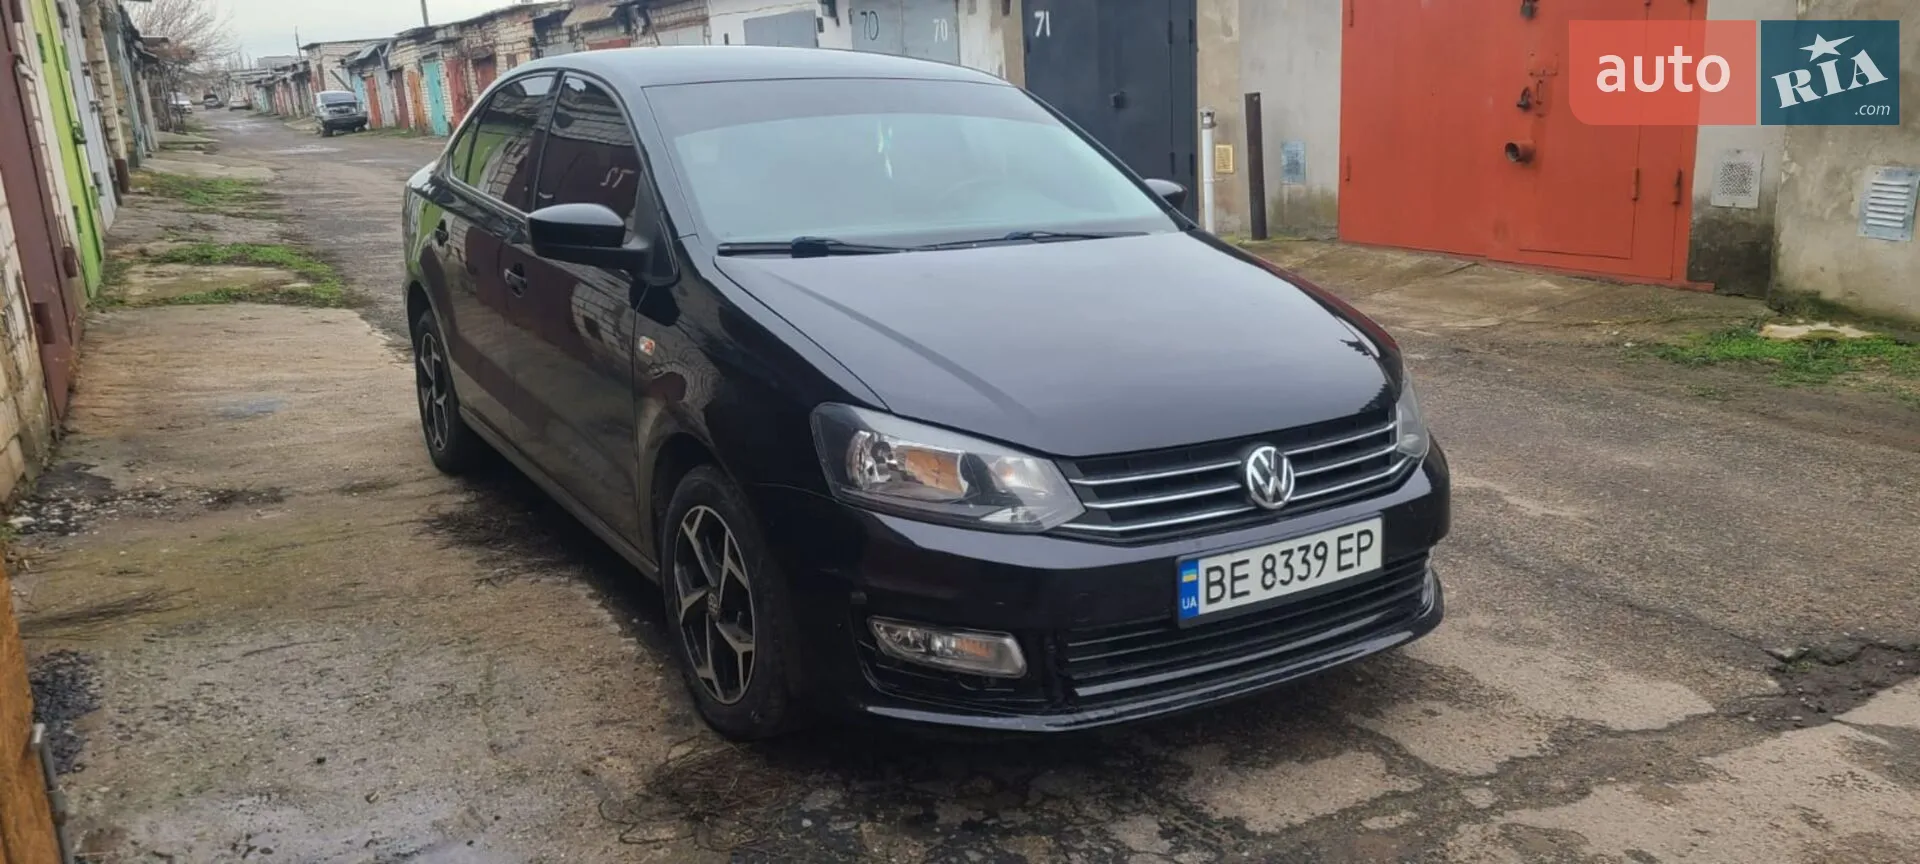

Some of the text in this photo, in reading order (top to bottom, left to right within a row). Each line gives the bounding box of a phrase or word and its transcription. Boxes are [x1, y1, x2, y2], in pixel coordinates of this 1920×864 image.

[860, 11, 879, 41] 70
[933, 18, 948, 43] 70
[1034, 11, 1051, 37] 71
[1206, 529, 1373, 605] BE 8339 EP
[1182, 598, 1197, 609] UA
